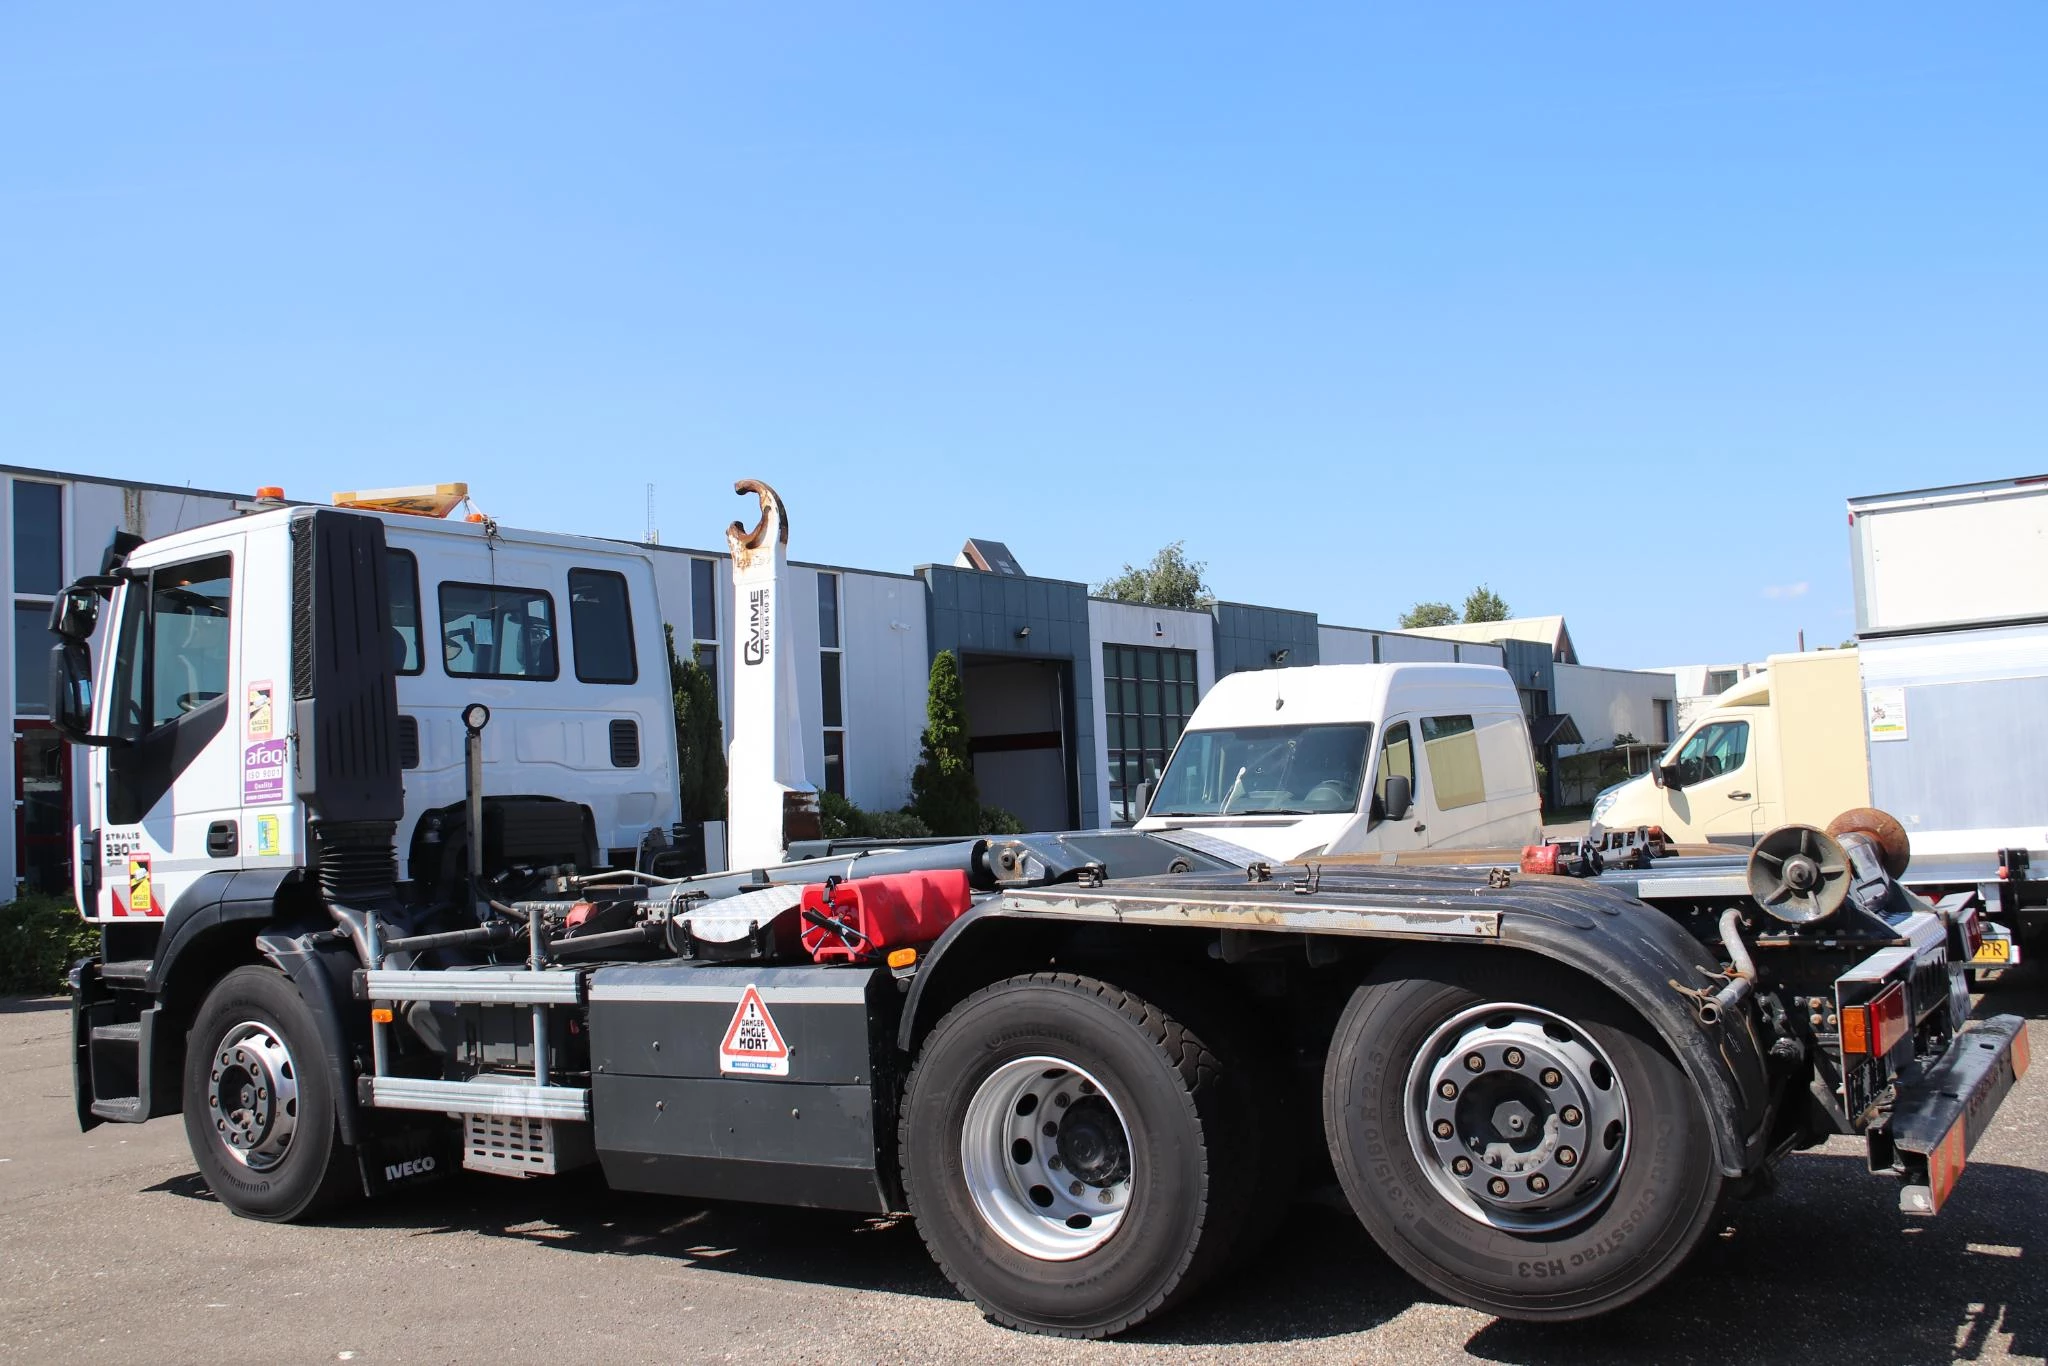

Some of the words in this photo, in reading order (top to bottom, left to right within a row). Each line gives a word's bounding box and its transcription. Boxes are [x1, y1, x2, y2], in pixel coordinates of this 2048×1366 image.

[764, 589, 770, 599] 35
[764, 602, 770, 613] 60
[744, 590, 764, 665] CAVIME
[764, 630, 770, 641] 60
[764, 644, 770, 655] 01
[246, 747, 283, 766] afaq
[248, 771, 260, 779] ISO
[263, 768, 280, 778] 9001
[105, 832, 140, 841] STRALIS
[106, 843, 129, 857] 330
[742, 1019, 765, 1027] DANGER
[741, 1027, 766, 1038] ANGLE
[739, 1037, 768, 1050] MORT
[385, 1156, 436, 1181] IVECO
[1518, 1257, 1567, 1278] HS3
